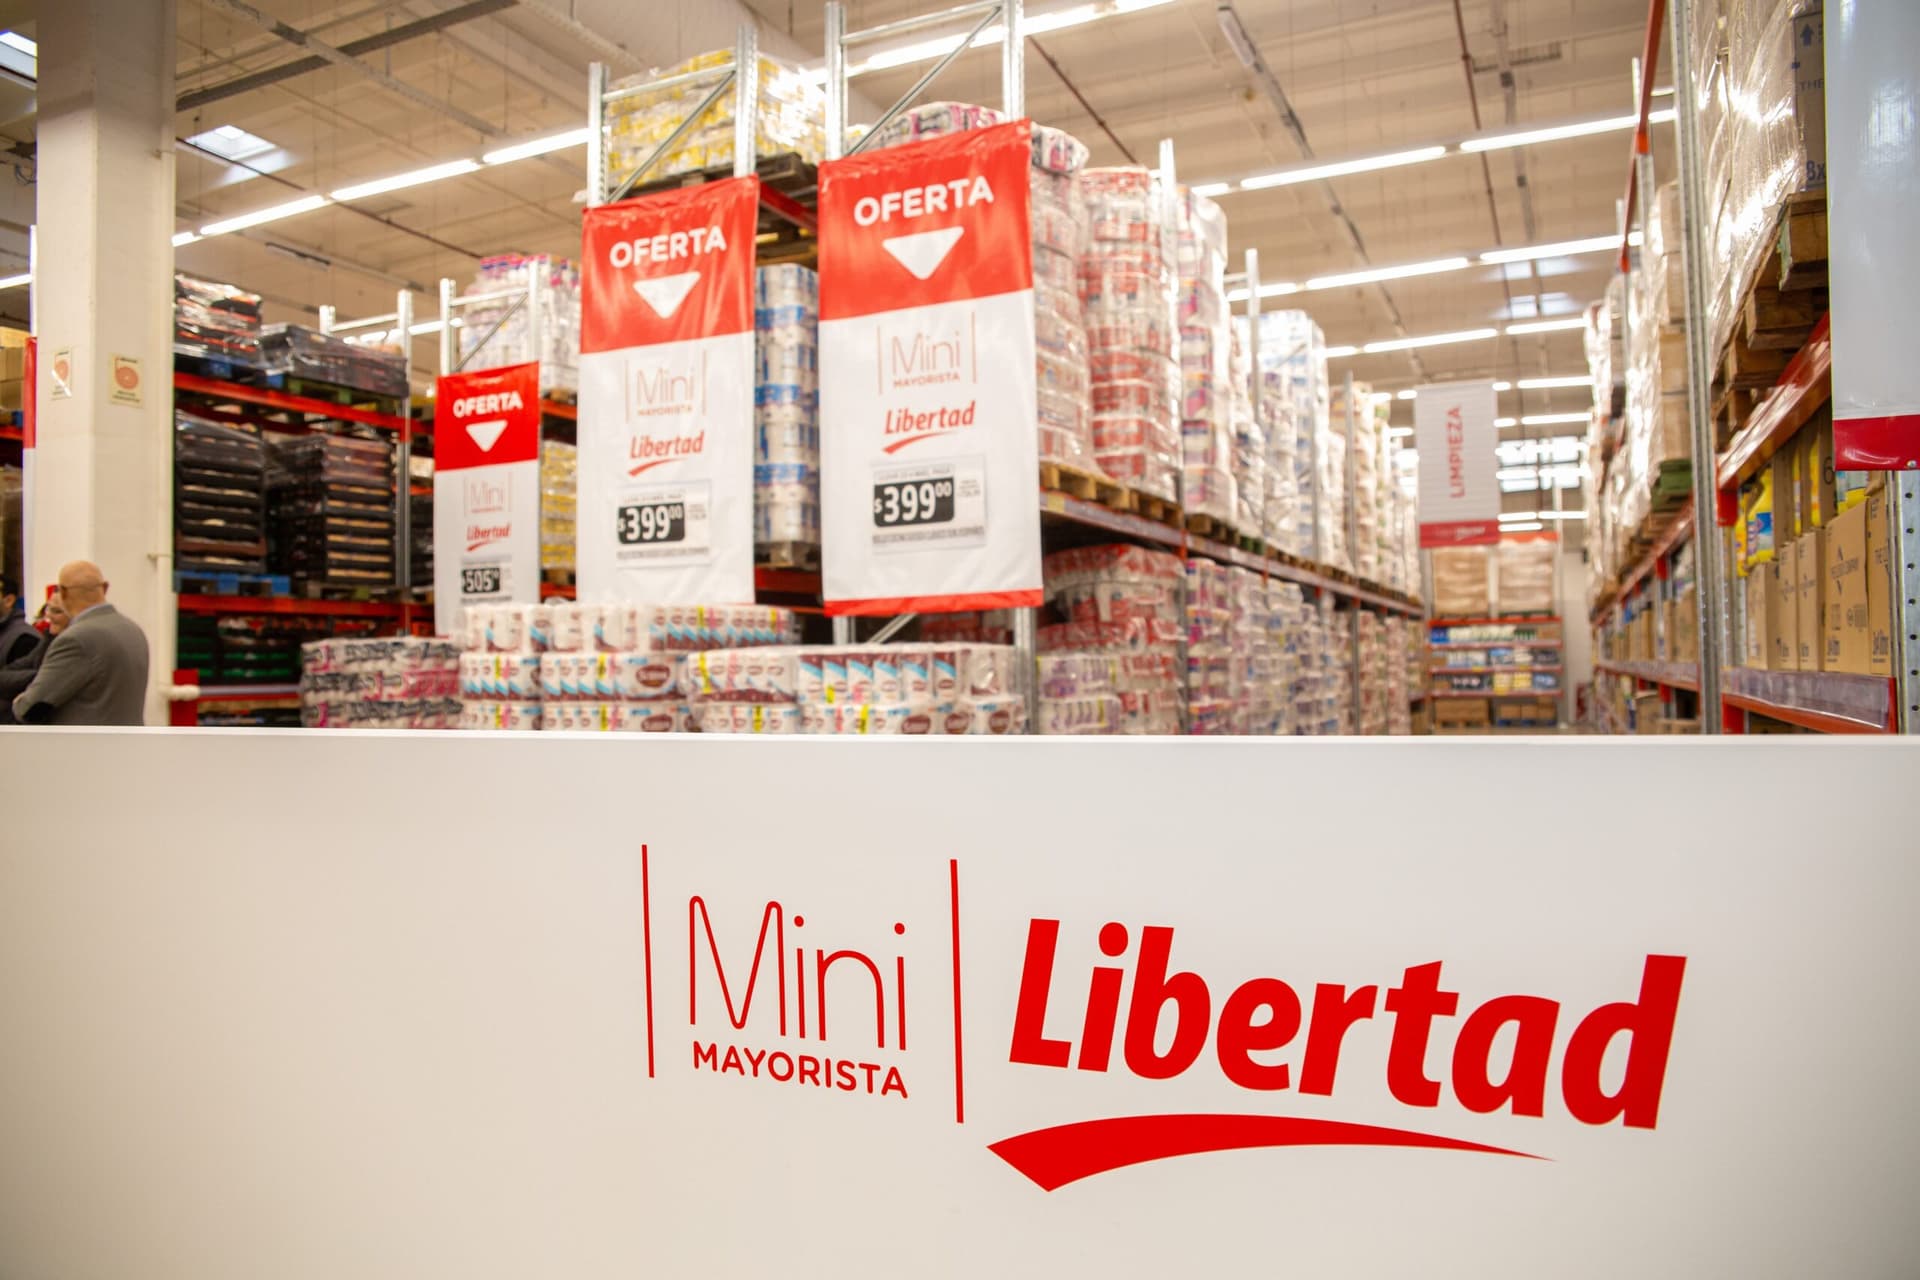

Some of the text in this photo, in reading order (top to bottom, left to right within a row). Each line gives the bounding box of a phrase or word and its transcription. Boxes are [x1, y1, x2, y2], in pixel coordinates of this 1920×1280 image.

[854, 175, 994, 226] OFERTA
[609, 225, 727, 269] OFERTA
[892, 330, 960, 374] Mini
[453, 391, 524, 418] OFERTA
[637, 367, 695, 406] Mini
[884, 399, 976, 435] Libertad
[630, 429, 704, 460] Libertad
[1446, 405, 1466, 498] LIMPIEZA
[466, 523, 512, 543] Libertad
[689, 895, 1688, 1130] Mini Libertad
[693, 1040, 909, 1099] MAYORISTA
